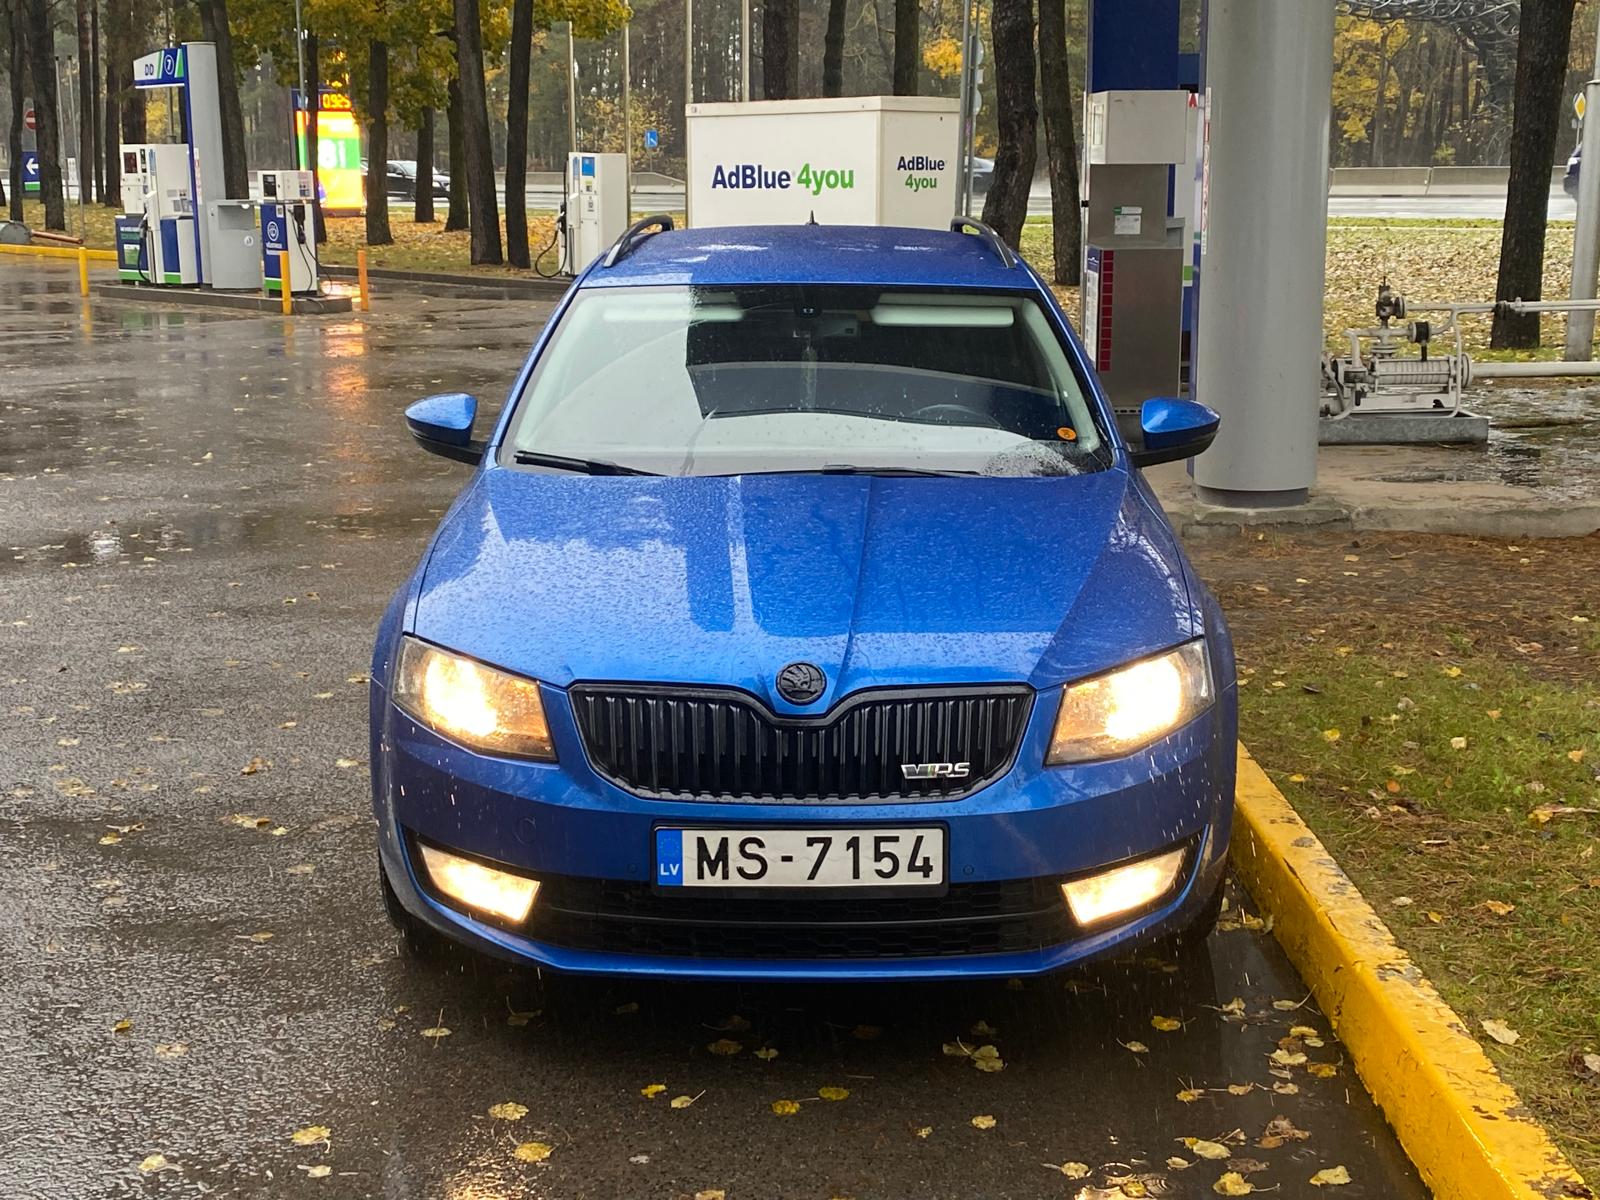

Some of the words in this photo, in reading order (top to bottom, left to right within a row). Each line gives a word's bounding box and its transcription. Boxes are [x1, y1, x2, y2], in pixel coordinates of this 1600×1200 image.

[897, 156, 945, 171] AdBlue
[711, 164, 791, 189] AdBlue
[797, 163, 855, 196] 4you
[905, 173, 938, 192] 4you
[696, 835, 934, 881] MS-7154
[660, 863, 680, 876] LV
